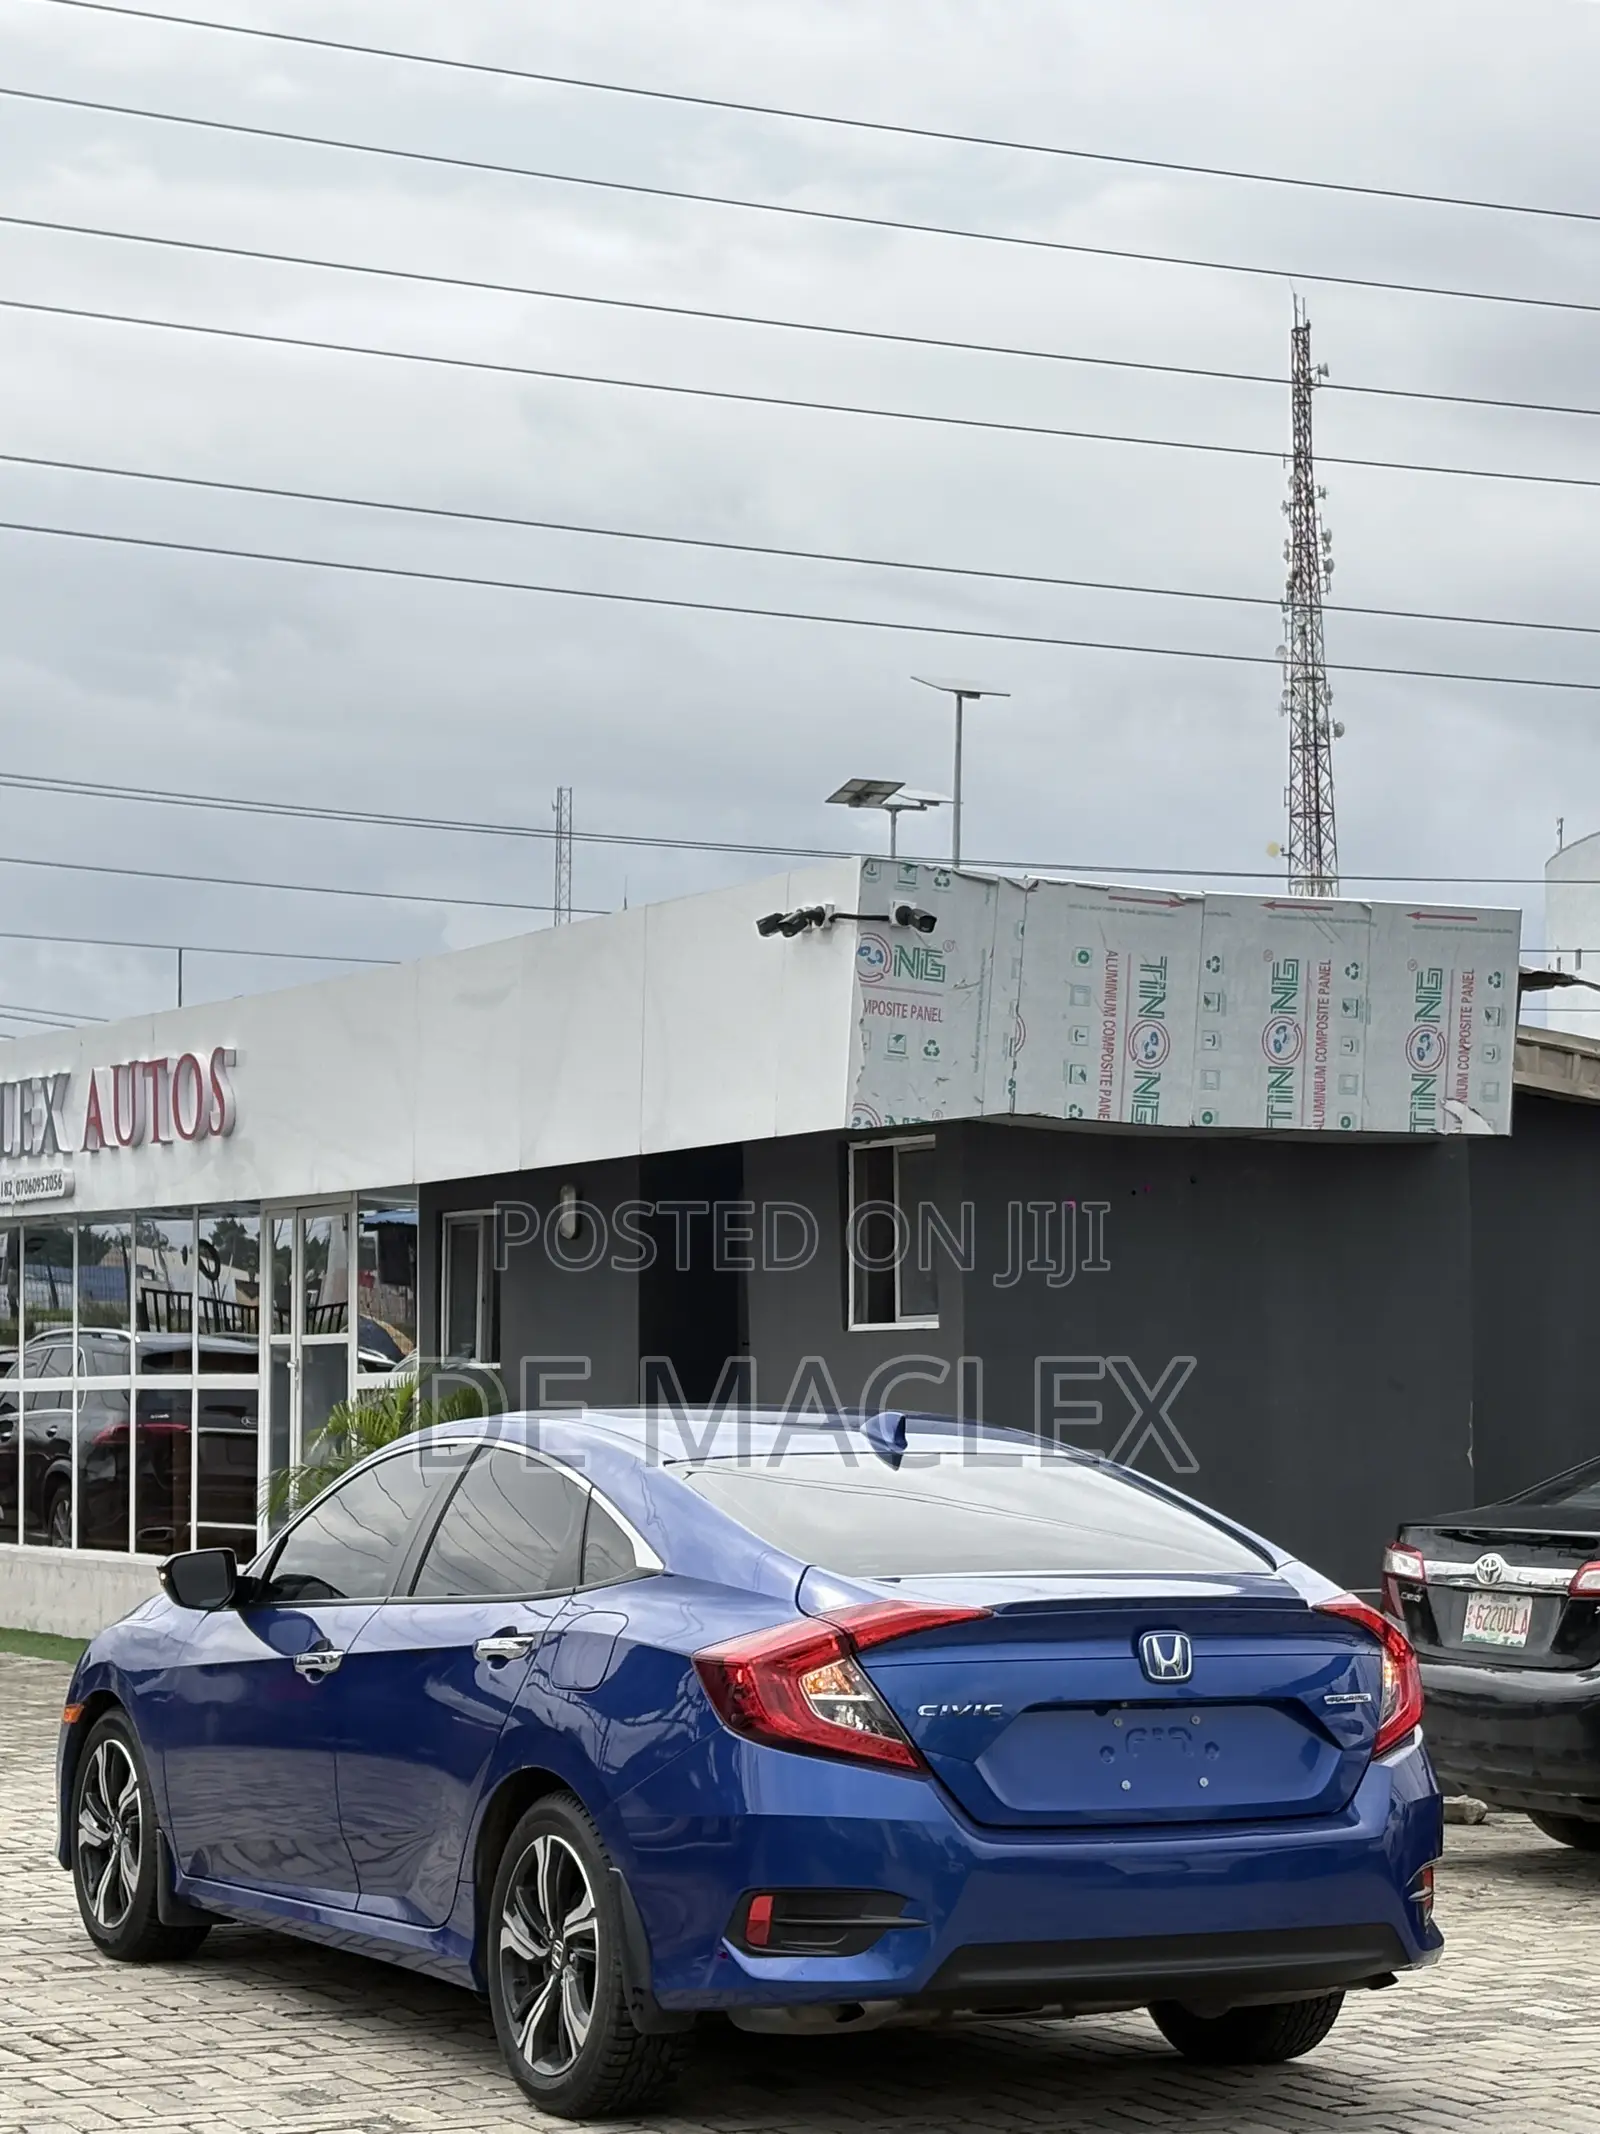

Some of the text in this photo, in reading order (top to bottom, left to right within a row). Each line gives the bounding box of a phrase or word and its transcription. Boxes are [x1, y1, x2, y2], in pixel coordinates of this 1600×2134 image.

[1102, 950, 1119, 1017] ALUMINIUM
[1318, 959, 1332, 995] PANEL
[1461, 969, 1475, 1004] PANEL
[910, 1006, 944, 1024] PANEL
[1315, 997, 1330, 1068] COMPOSITE
[1457, 1005, 1473, 1073] COMPOSITE
[1099, 1019, 1117, 1086] COMPOSITE
[80, 1047, 237, 1153] AUTOS
[917, 1703, 1004, 1717] CIVIC
